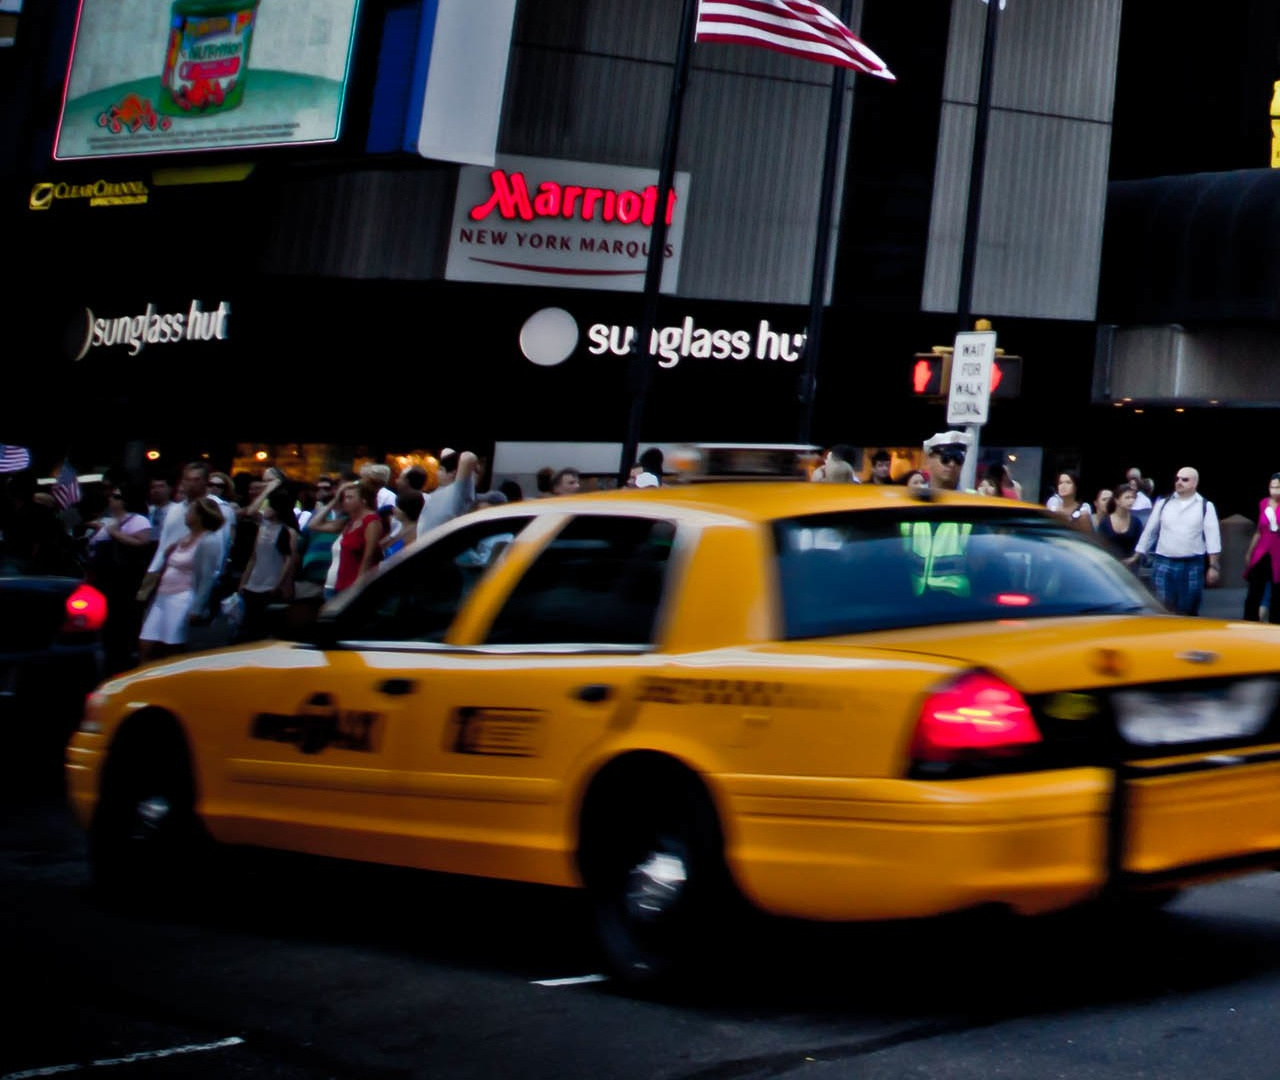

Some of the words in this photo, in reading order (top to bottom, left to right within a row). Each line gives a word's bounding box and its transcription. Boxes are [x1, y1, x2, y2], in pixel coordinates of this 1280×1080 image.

[459, 227, 502, 248] NEW
[515, 231, 572, 252] YORK
[579, 237, 674, 260] MARQUS
[92, 304, 182, 356] sunglass
[187, 300, 230, 341] hut
[757, 320, 806, 362] hu
